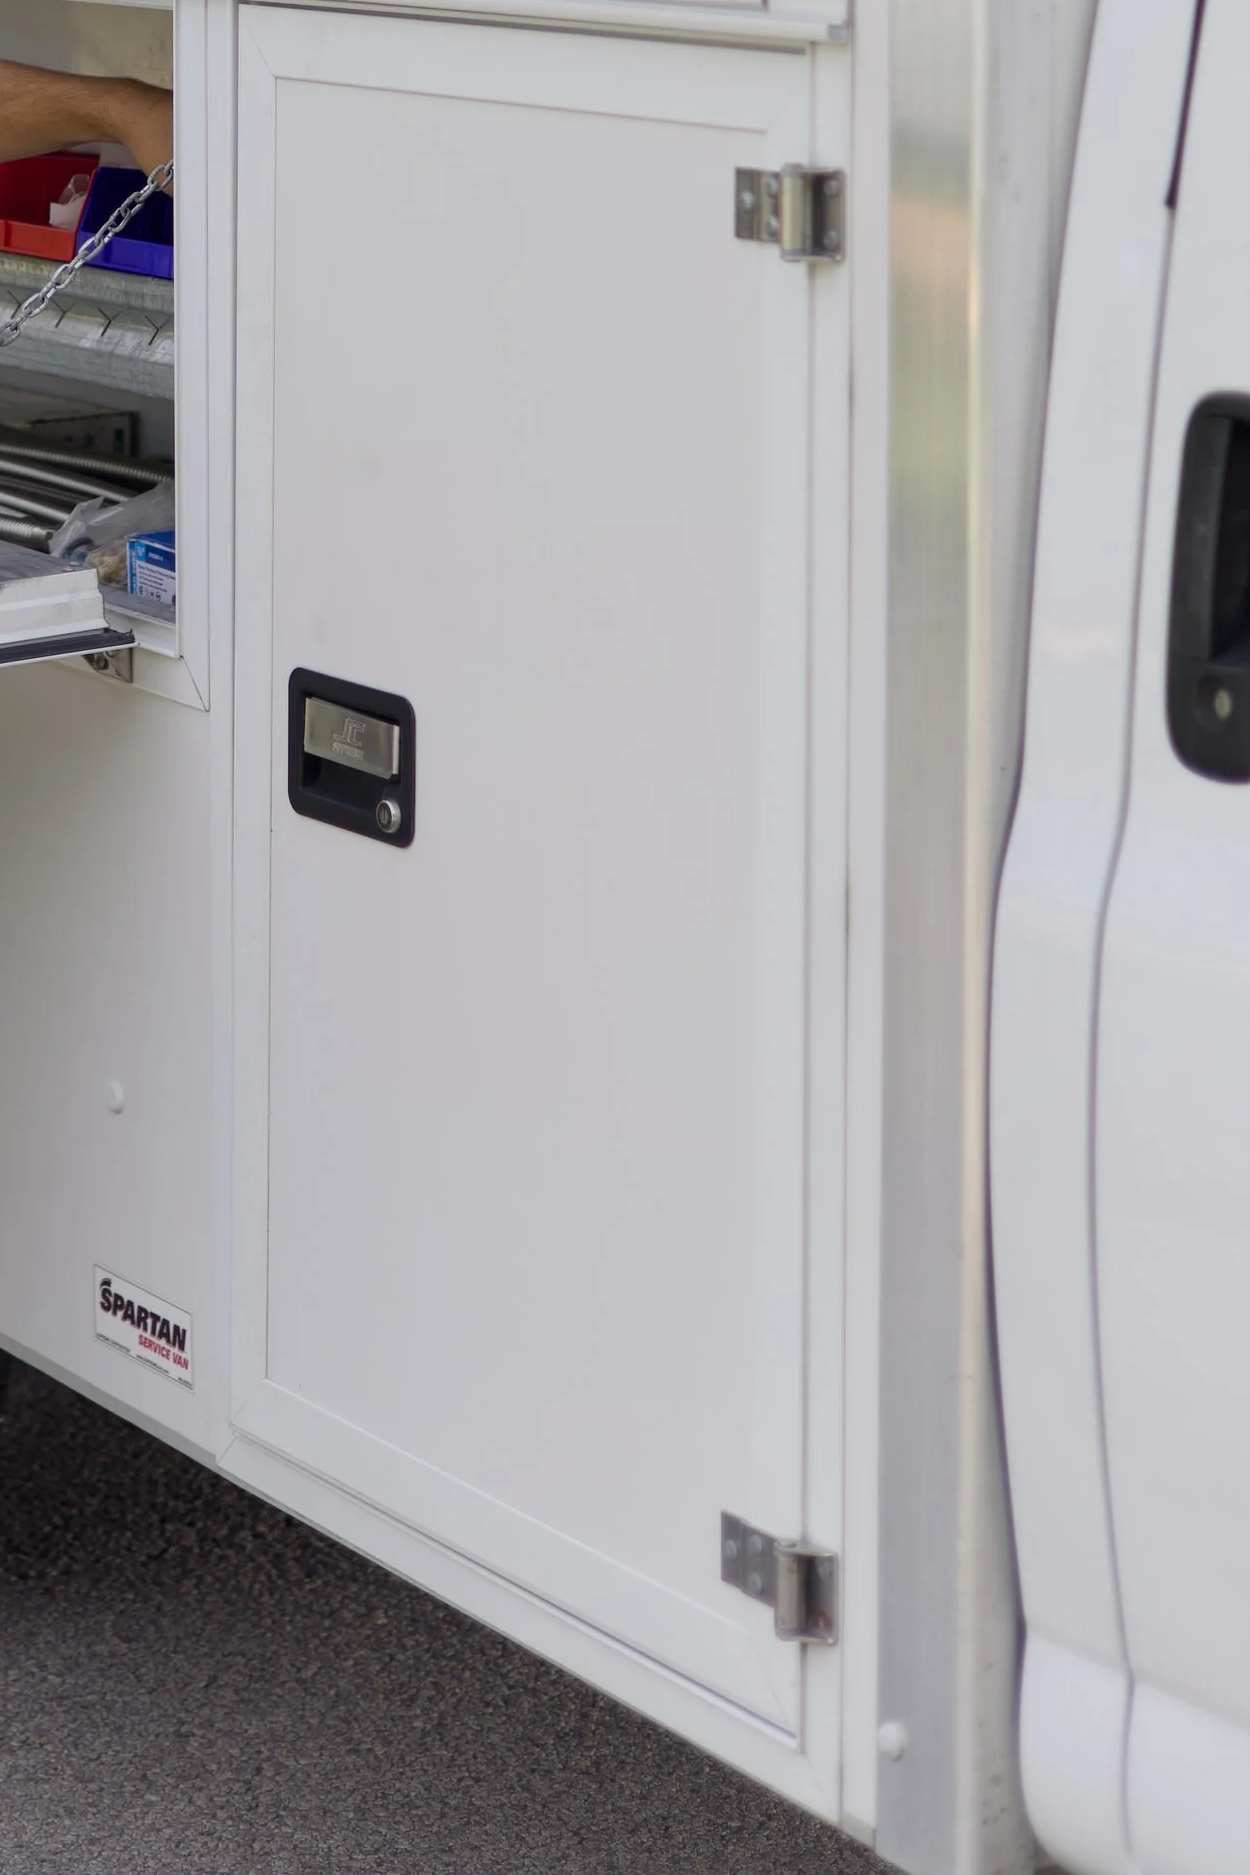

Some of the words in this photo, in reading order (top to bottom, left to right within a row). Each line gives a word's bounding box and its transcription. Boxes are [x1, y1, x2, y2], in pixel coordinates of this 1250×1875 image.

[100, 1285, 187, 1353] SPARTAN
[138, 1334, 171, 1360] SERVICE
[172, 1351, 189, 1371] VAN
